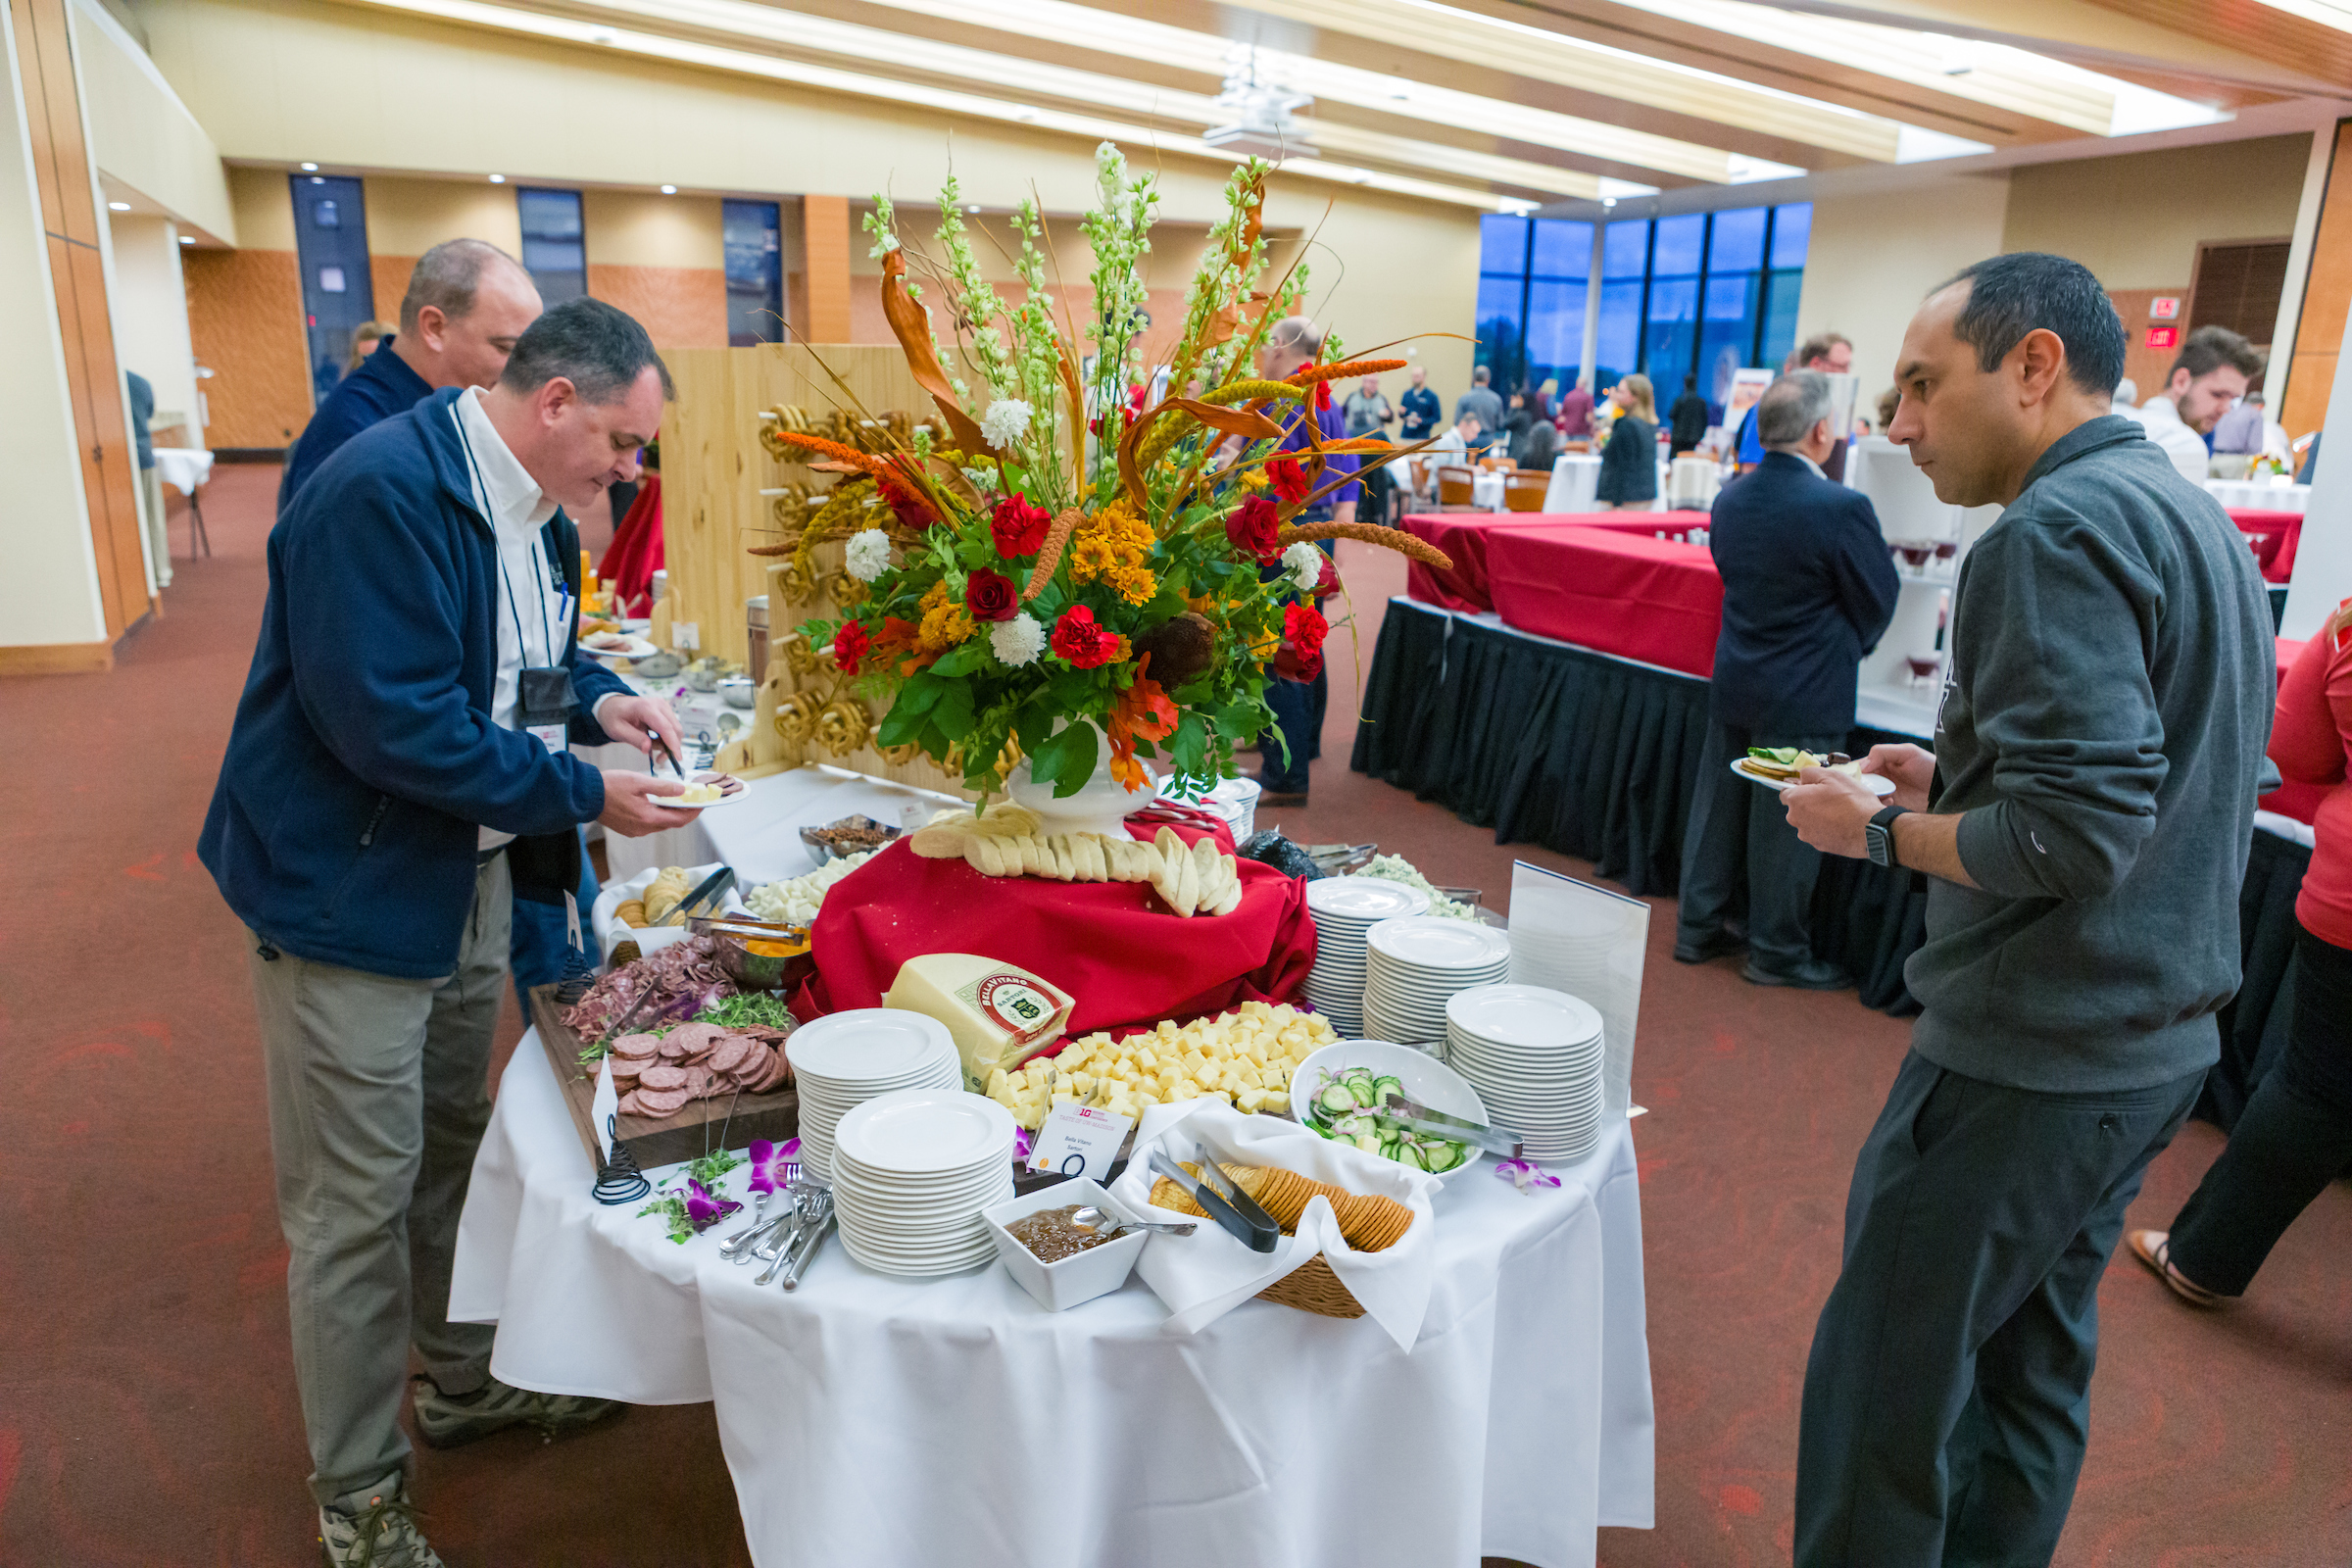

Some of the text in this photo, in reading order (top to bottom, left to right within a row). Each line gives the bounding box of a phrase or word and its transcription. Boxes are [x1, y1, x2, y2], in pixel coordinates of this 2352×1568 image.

[981, 976, 1028, 1006] BELLAVITANO
[997, 988, 1027, 1007] SARTORI
[1059, 1114, 1074, 1123] TASTE
